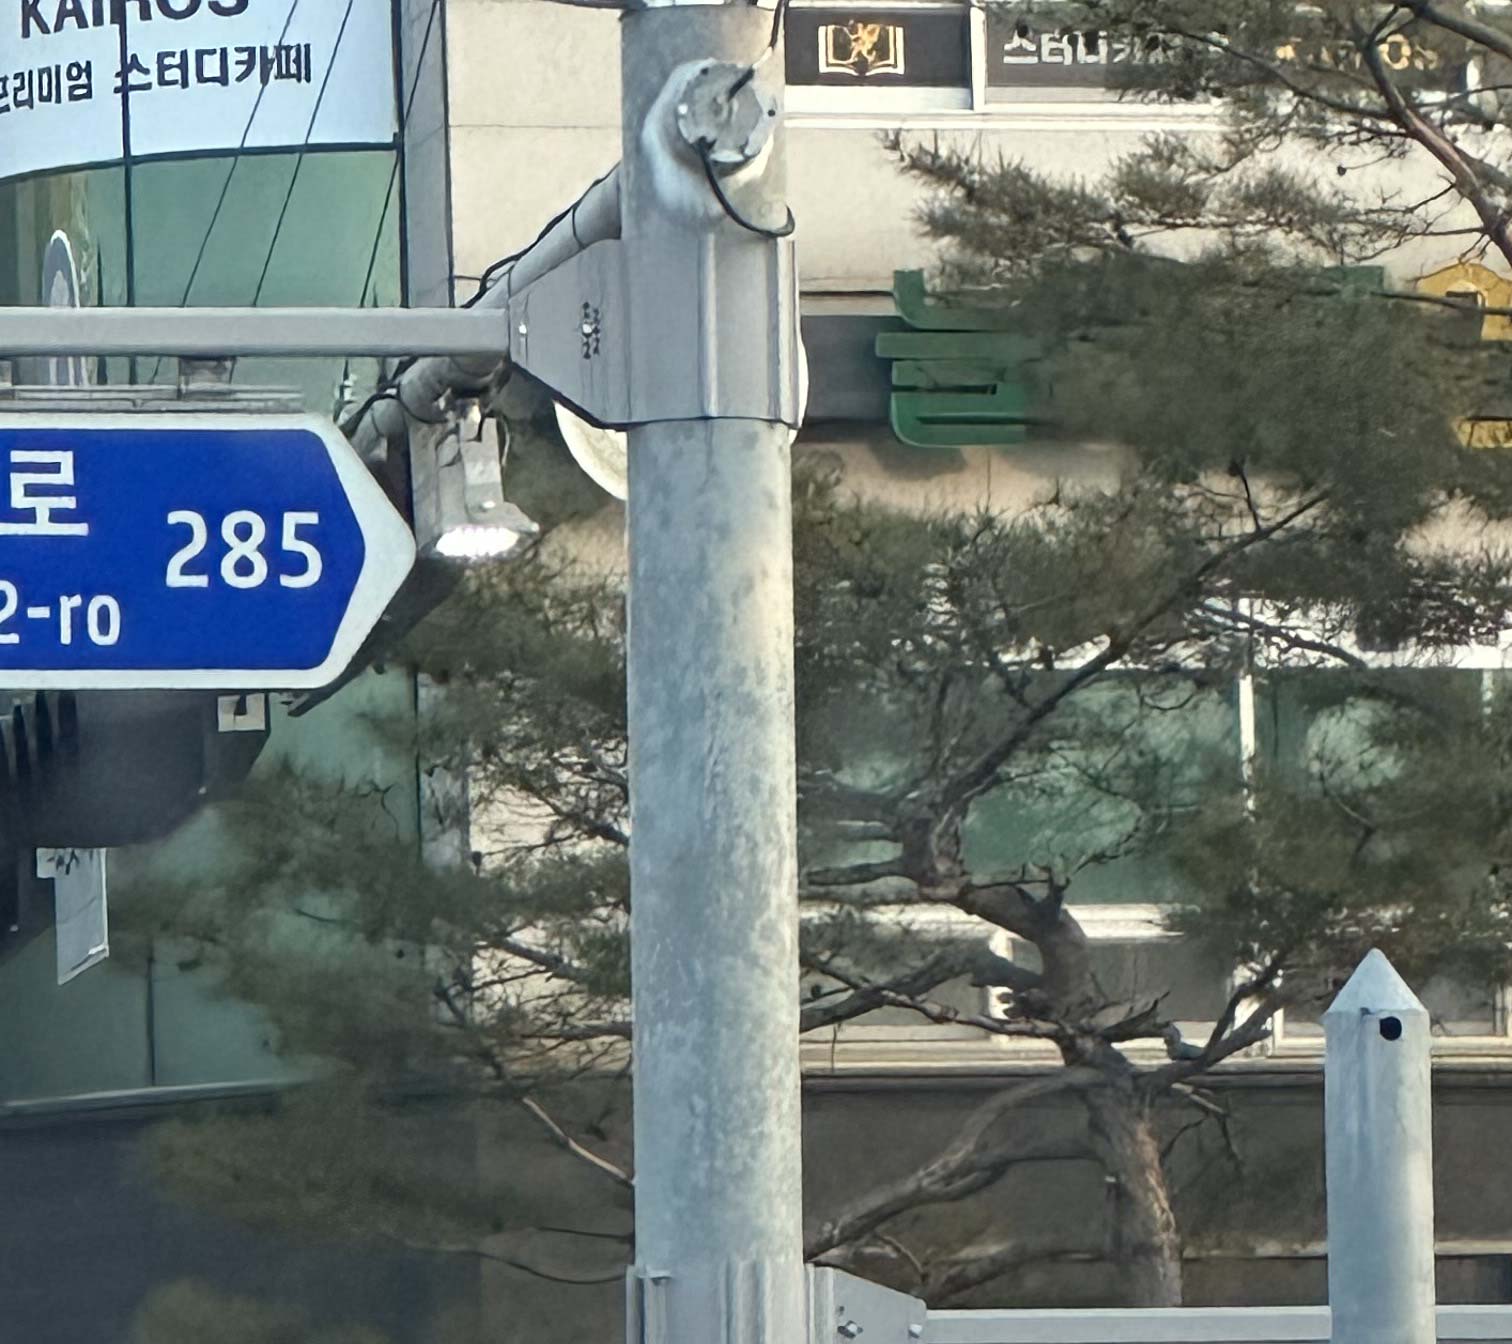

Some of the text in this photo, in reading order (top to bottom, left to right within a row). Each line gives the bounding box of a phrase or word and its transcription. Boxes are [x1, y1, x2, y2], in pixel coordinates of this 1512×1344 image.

[113, 43, 312, 95] 스터디카페
[0, 450, 323, 589] 로 285
